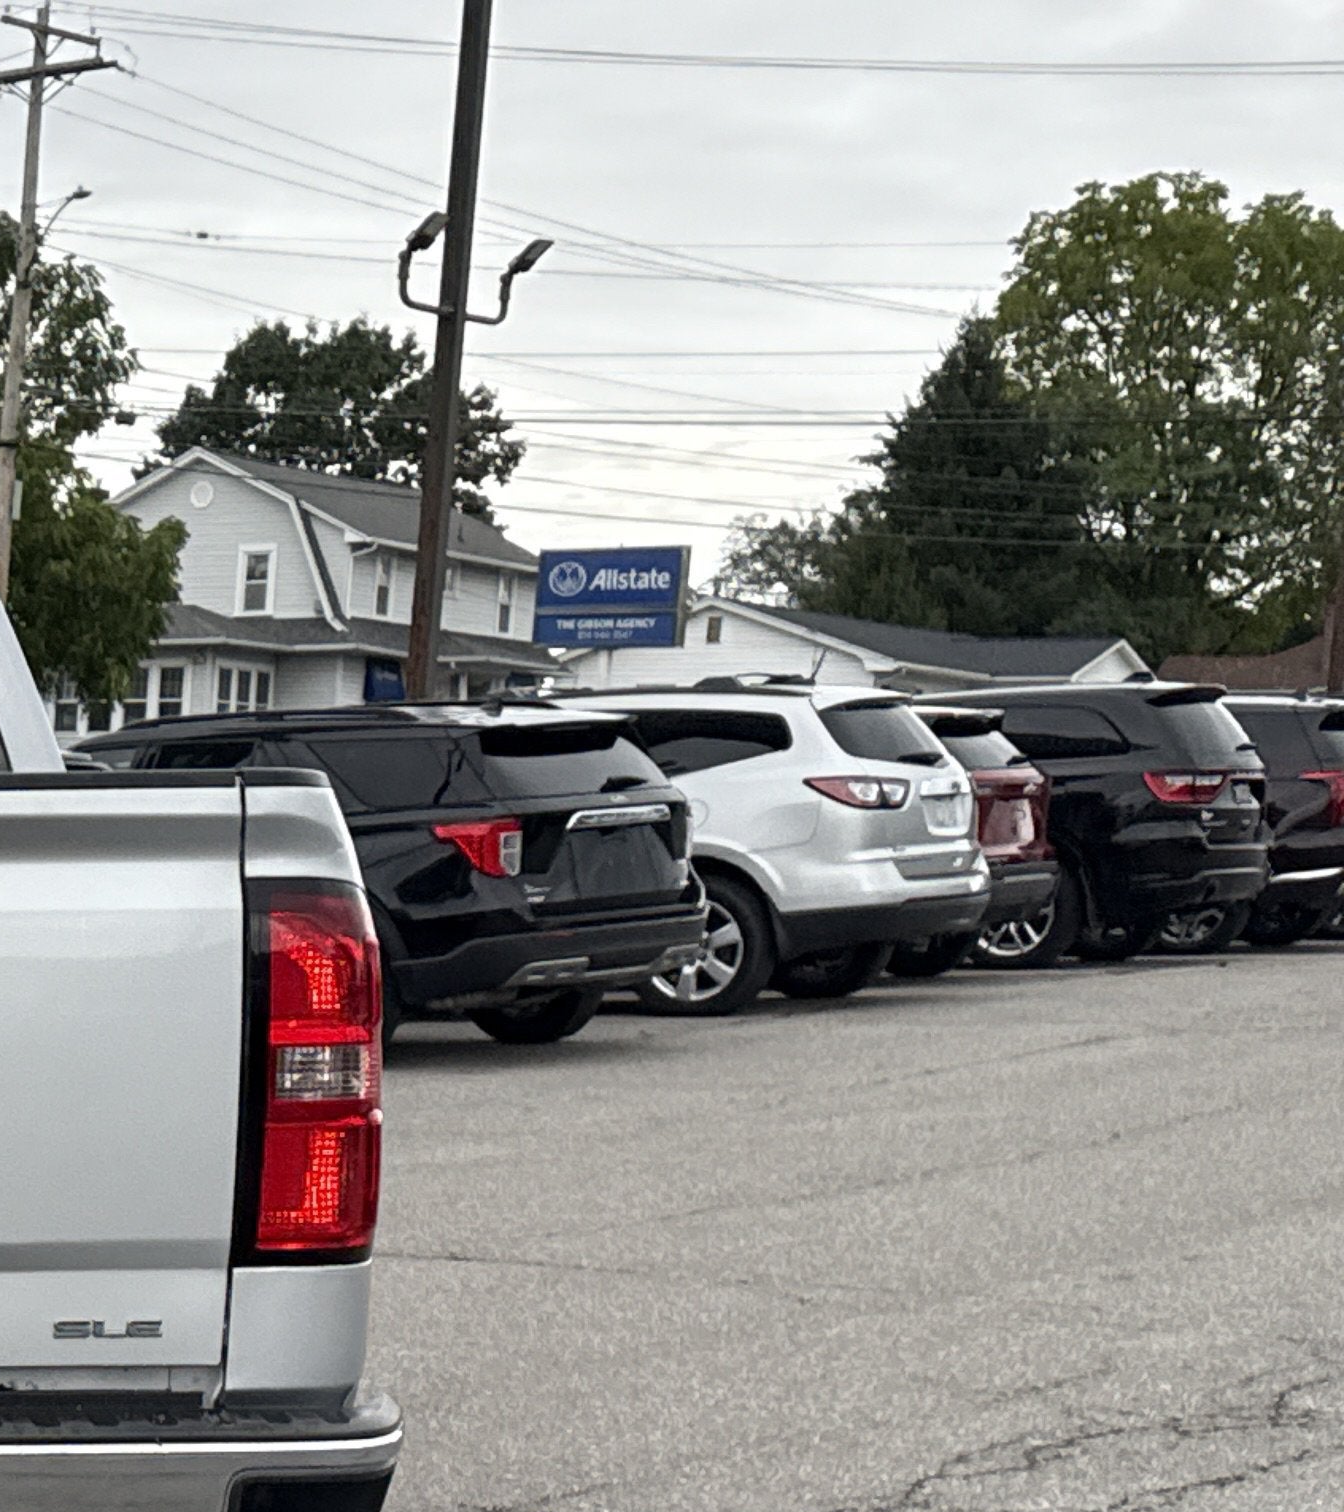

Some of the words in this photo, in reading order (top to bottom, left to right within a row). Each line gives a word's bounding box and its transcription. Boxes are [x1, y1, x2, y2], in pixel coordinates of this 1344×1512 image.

[588, 567, 672, 592] Allstate
[556, 618, 575, 630] THE
[577, 617, 614, 630] GIBSON
[616, 616, 657, 629] AGENCY
[53, 1320, 162, 1340] SLE
